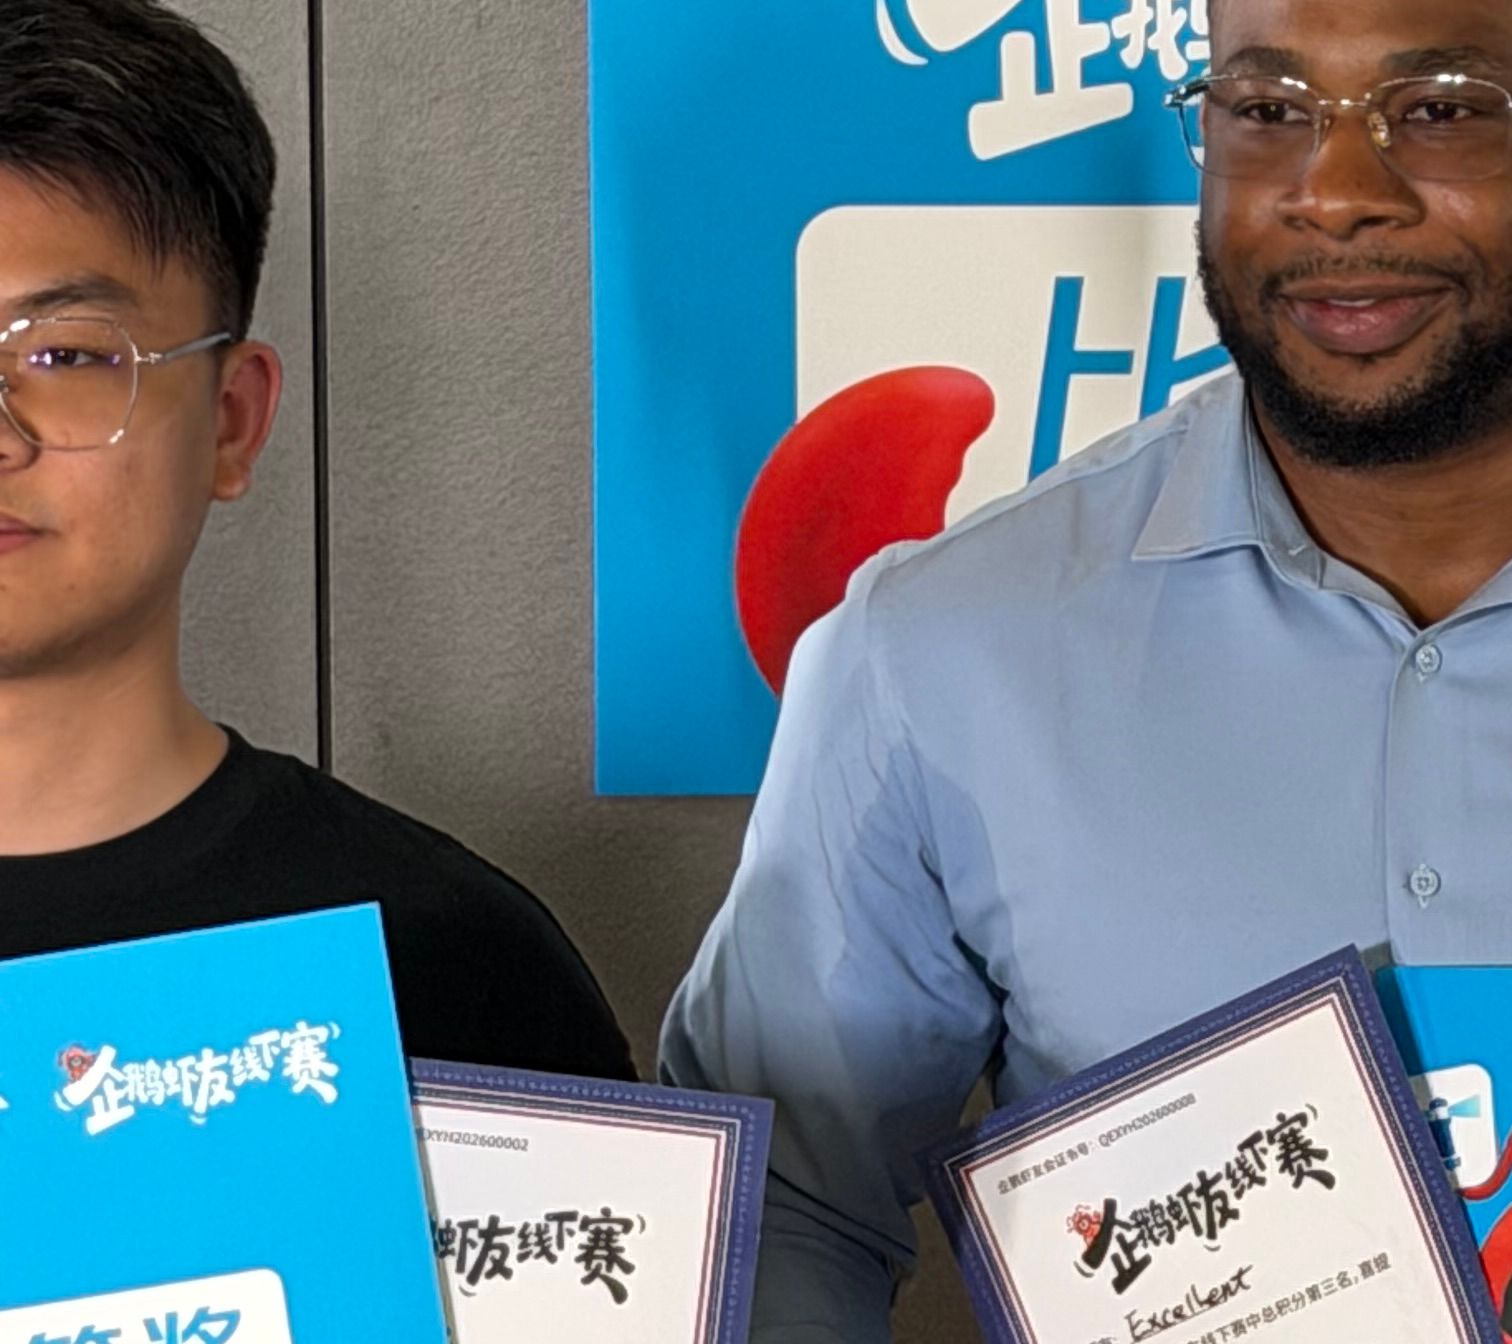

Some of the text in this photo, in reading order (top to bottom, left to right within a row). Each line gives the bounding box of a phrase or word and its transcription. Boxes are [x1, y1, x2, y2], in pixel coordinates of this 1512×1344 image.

[66, 1021, 340, 1136] 企鹅虾友线下赛
[430, 1206, 636, 1305] 虾友线下赛
[1081, 1111, 1336, 1296] 企鹅虾友线下赛
